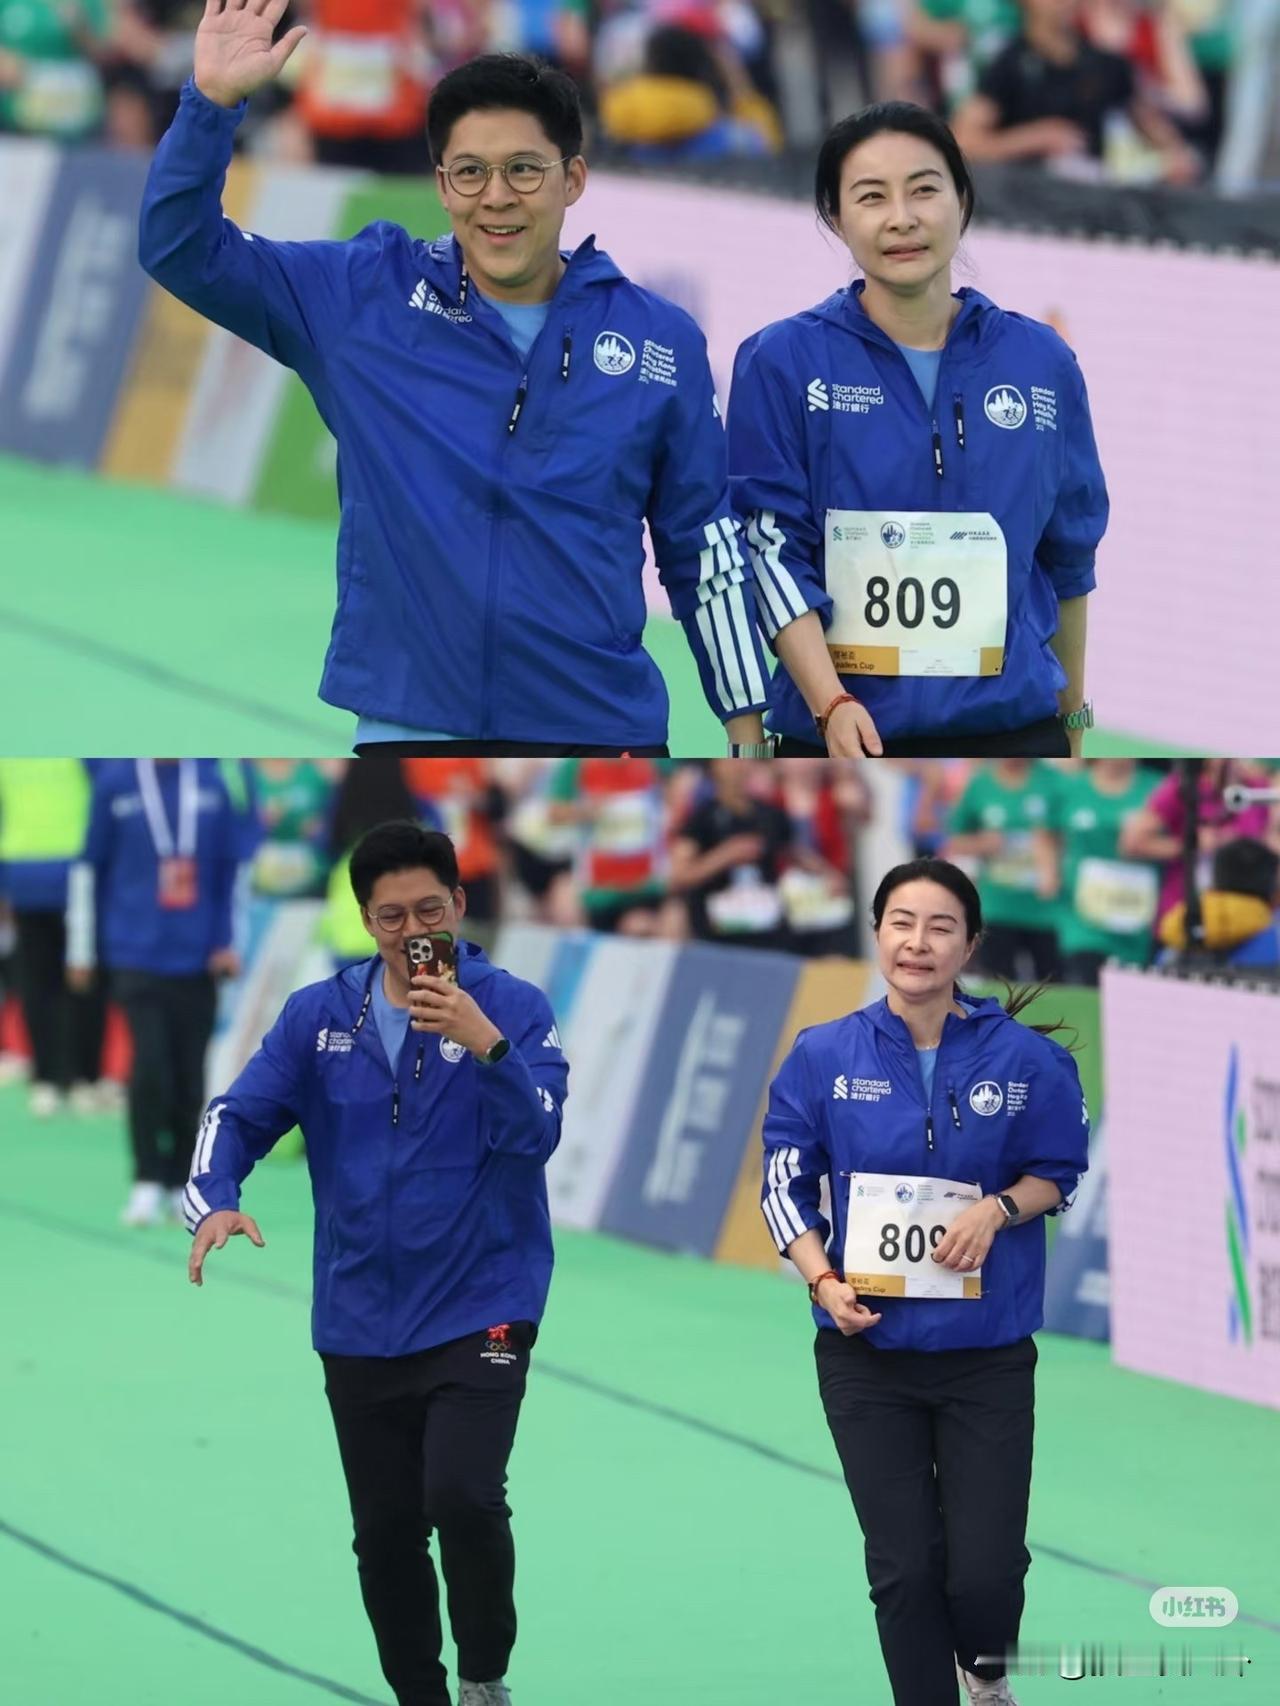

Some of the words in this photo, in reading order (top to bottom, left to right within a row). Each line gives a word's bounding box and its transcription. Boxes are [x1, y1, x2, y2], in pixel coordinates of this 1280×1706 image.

[832, 383, 881, 396] standard
[832, 392, 884, 405] chartered
[864, 576, 961, 629] 809
[859, 661, 875, 672] Cup
